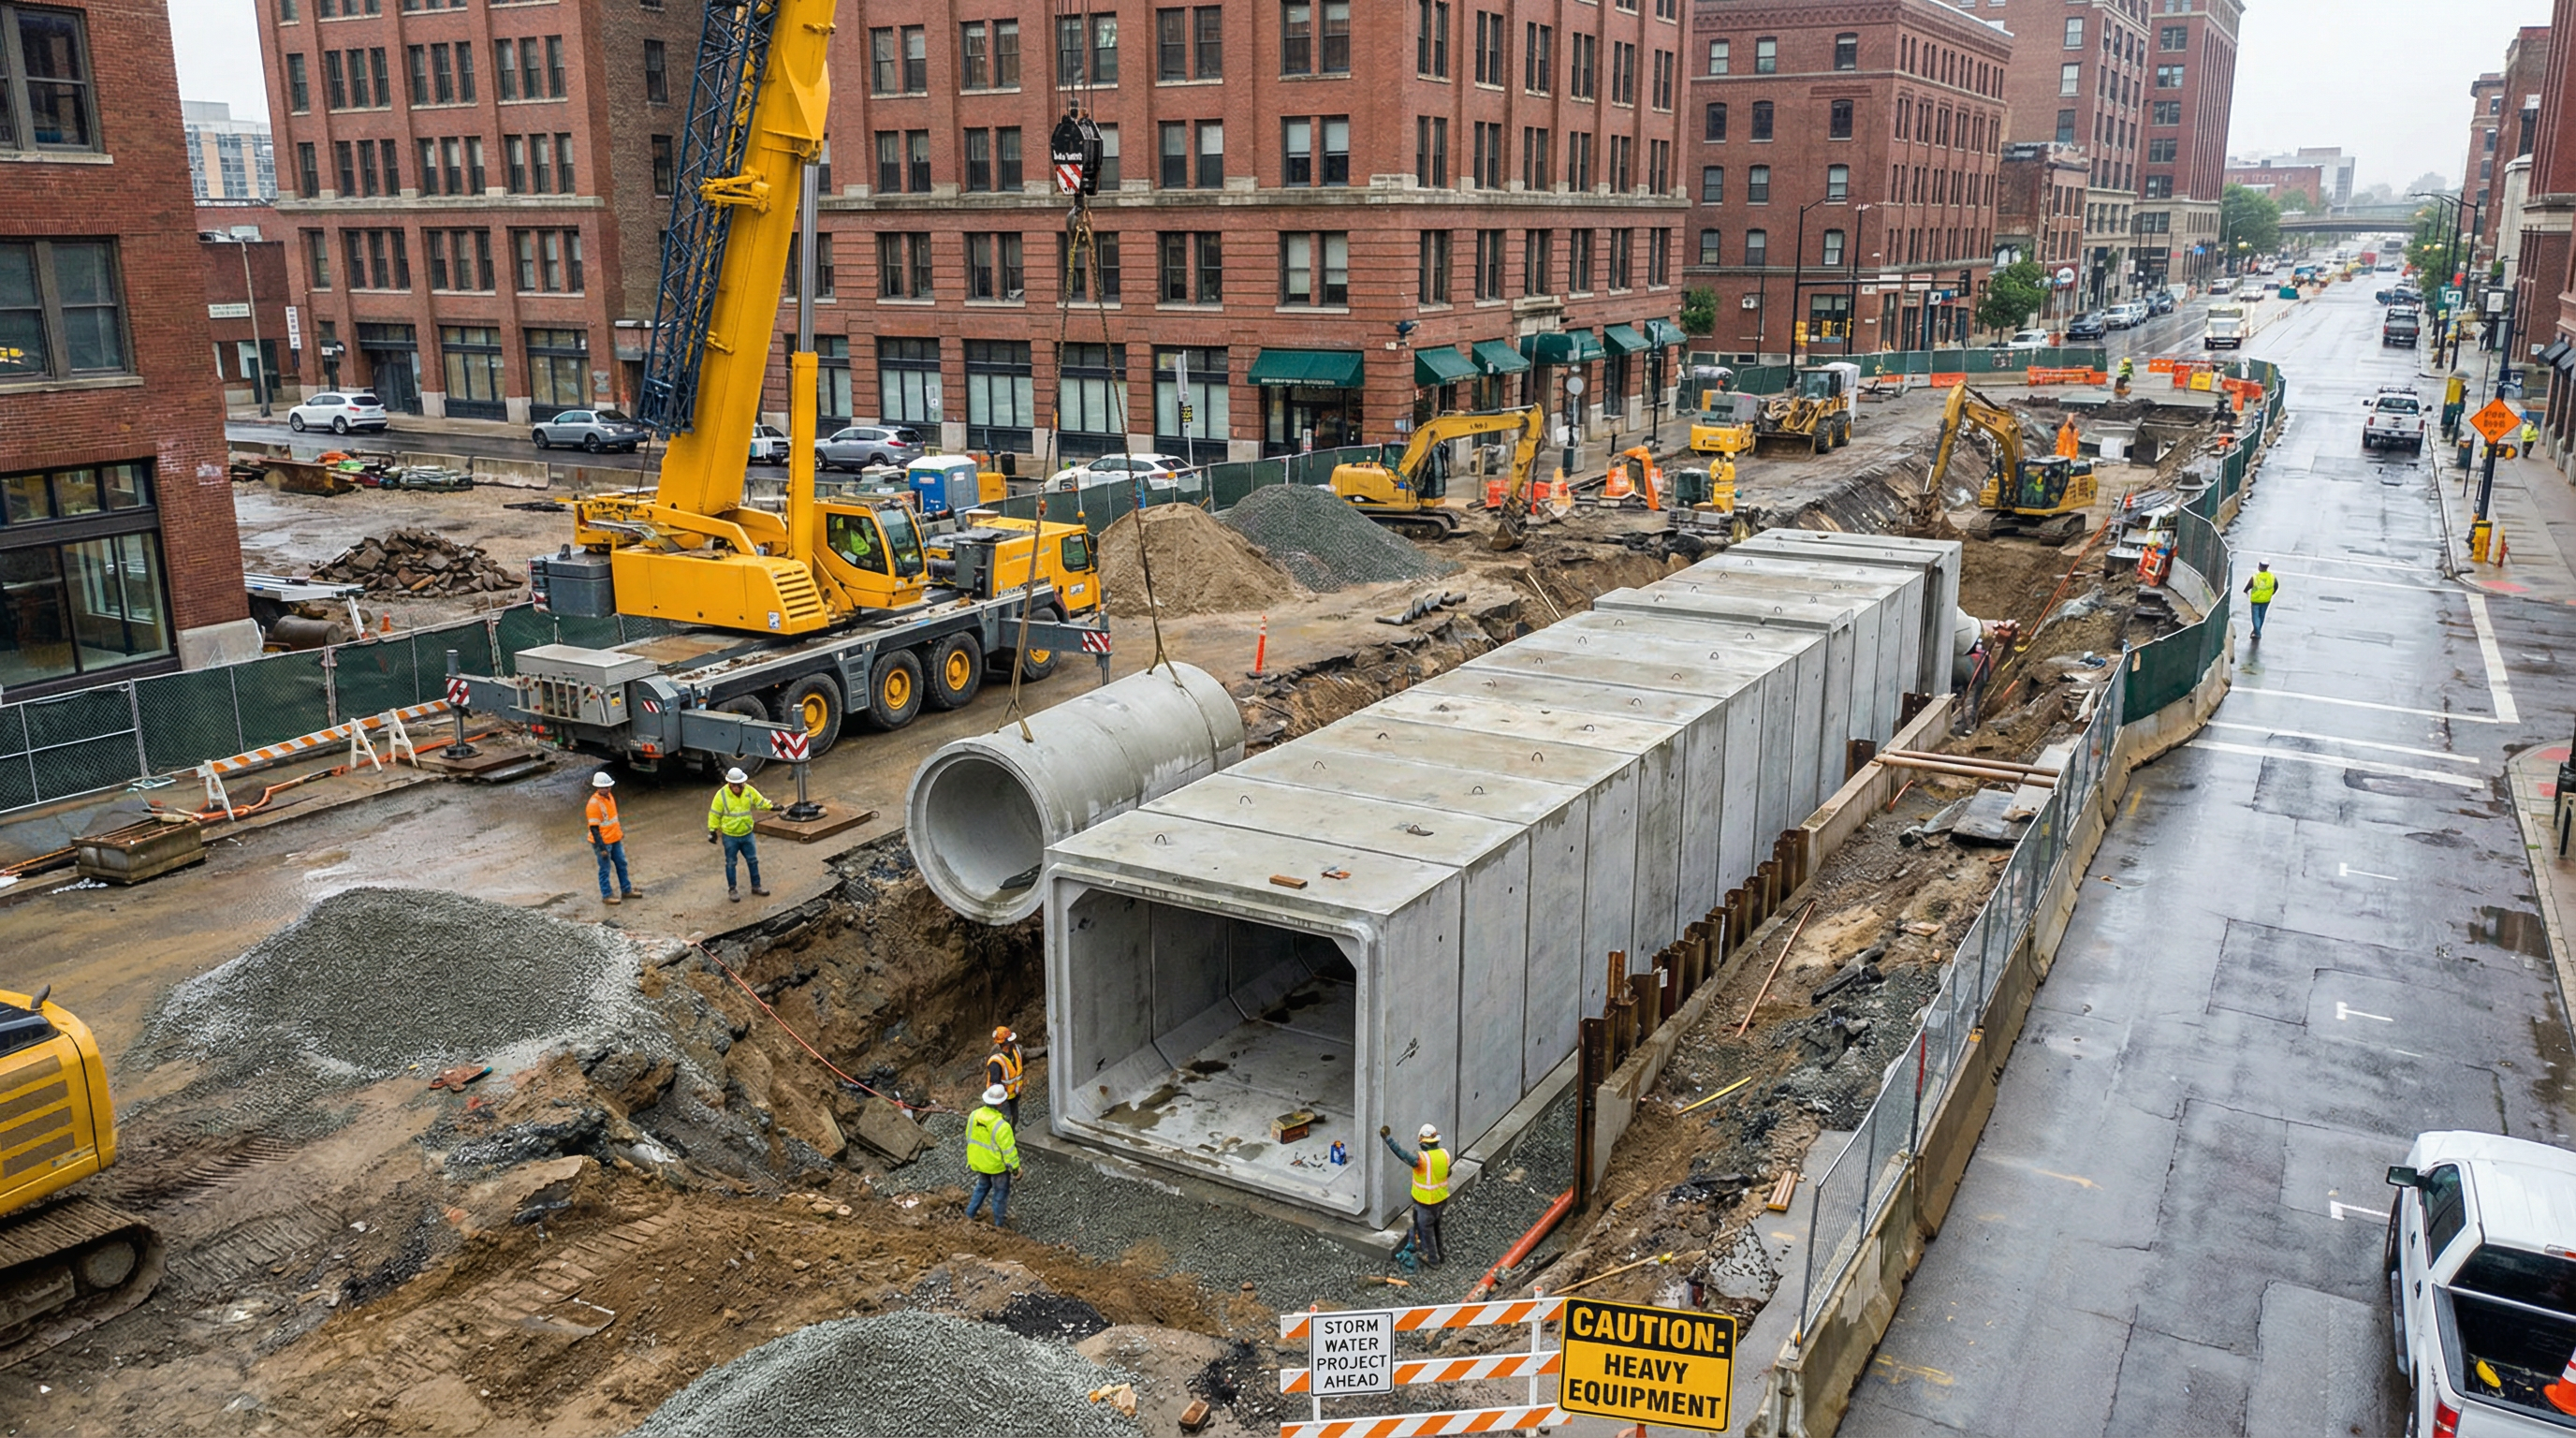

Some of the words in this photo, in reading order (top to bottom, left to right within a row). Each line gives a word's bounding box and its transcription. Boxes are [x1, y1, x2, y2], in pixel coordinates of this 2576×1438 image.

[1325, 1319, 1379, 1334] STORM
[1573, 1306, 1726, 1354] CAUTION:
[1325, 1338, 1379, 1352] WATER
[1317, 1355, 1387, 1371] PROJECT
[1604, 1353, 1689, 1385] HEAVY
[1324, 1373, 1379, 1388] AHEAD
[1568, 1378, 1721, 1419] EQUIPMENT
